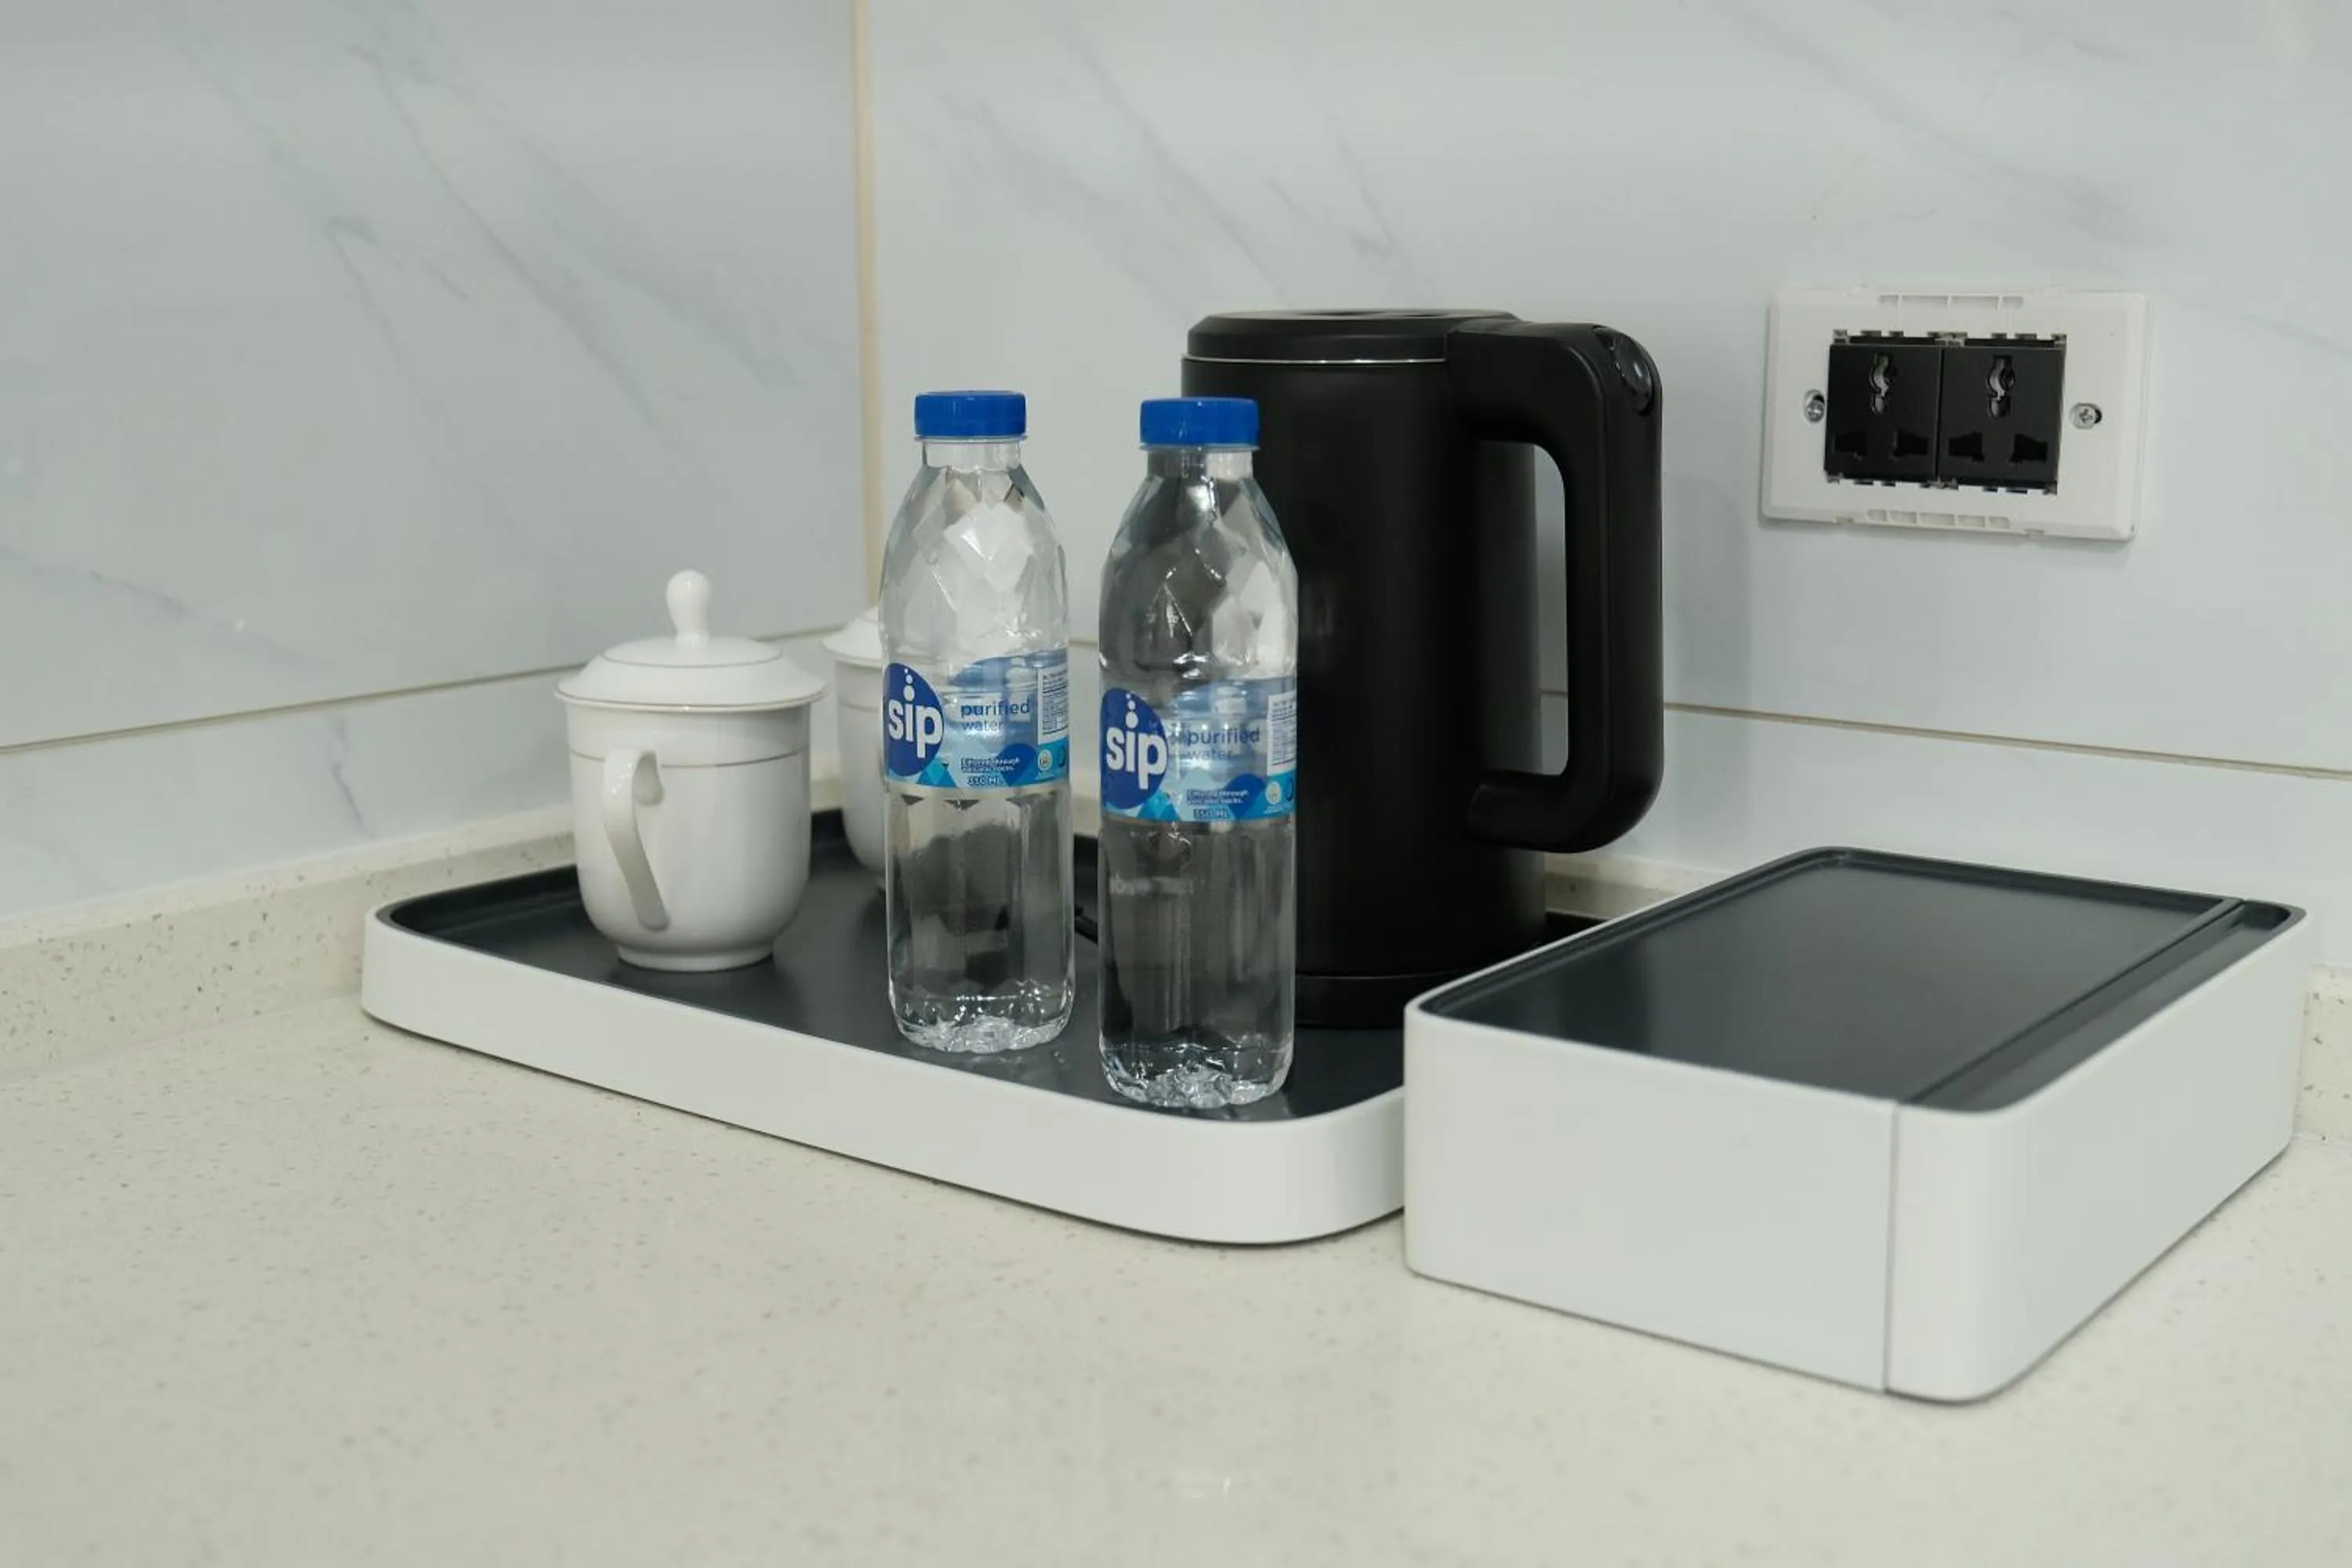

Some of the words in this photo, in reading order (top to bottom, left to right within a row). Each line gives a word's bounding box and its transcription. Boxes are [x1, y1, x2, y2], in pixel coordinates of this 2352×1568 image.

[960, 697, 1030, 717] purified
[888, 685, 942, 759] sip
[961, 718, 1004, 731] water
[1187, 727, 1261, 745] purified
[1106, 711, 1167, 790] sip
[1186, 749, 1232, 760] water
